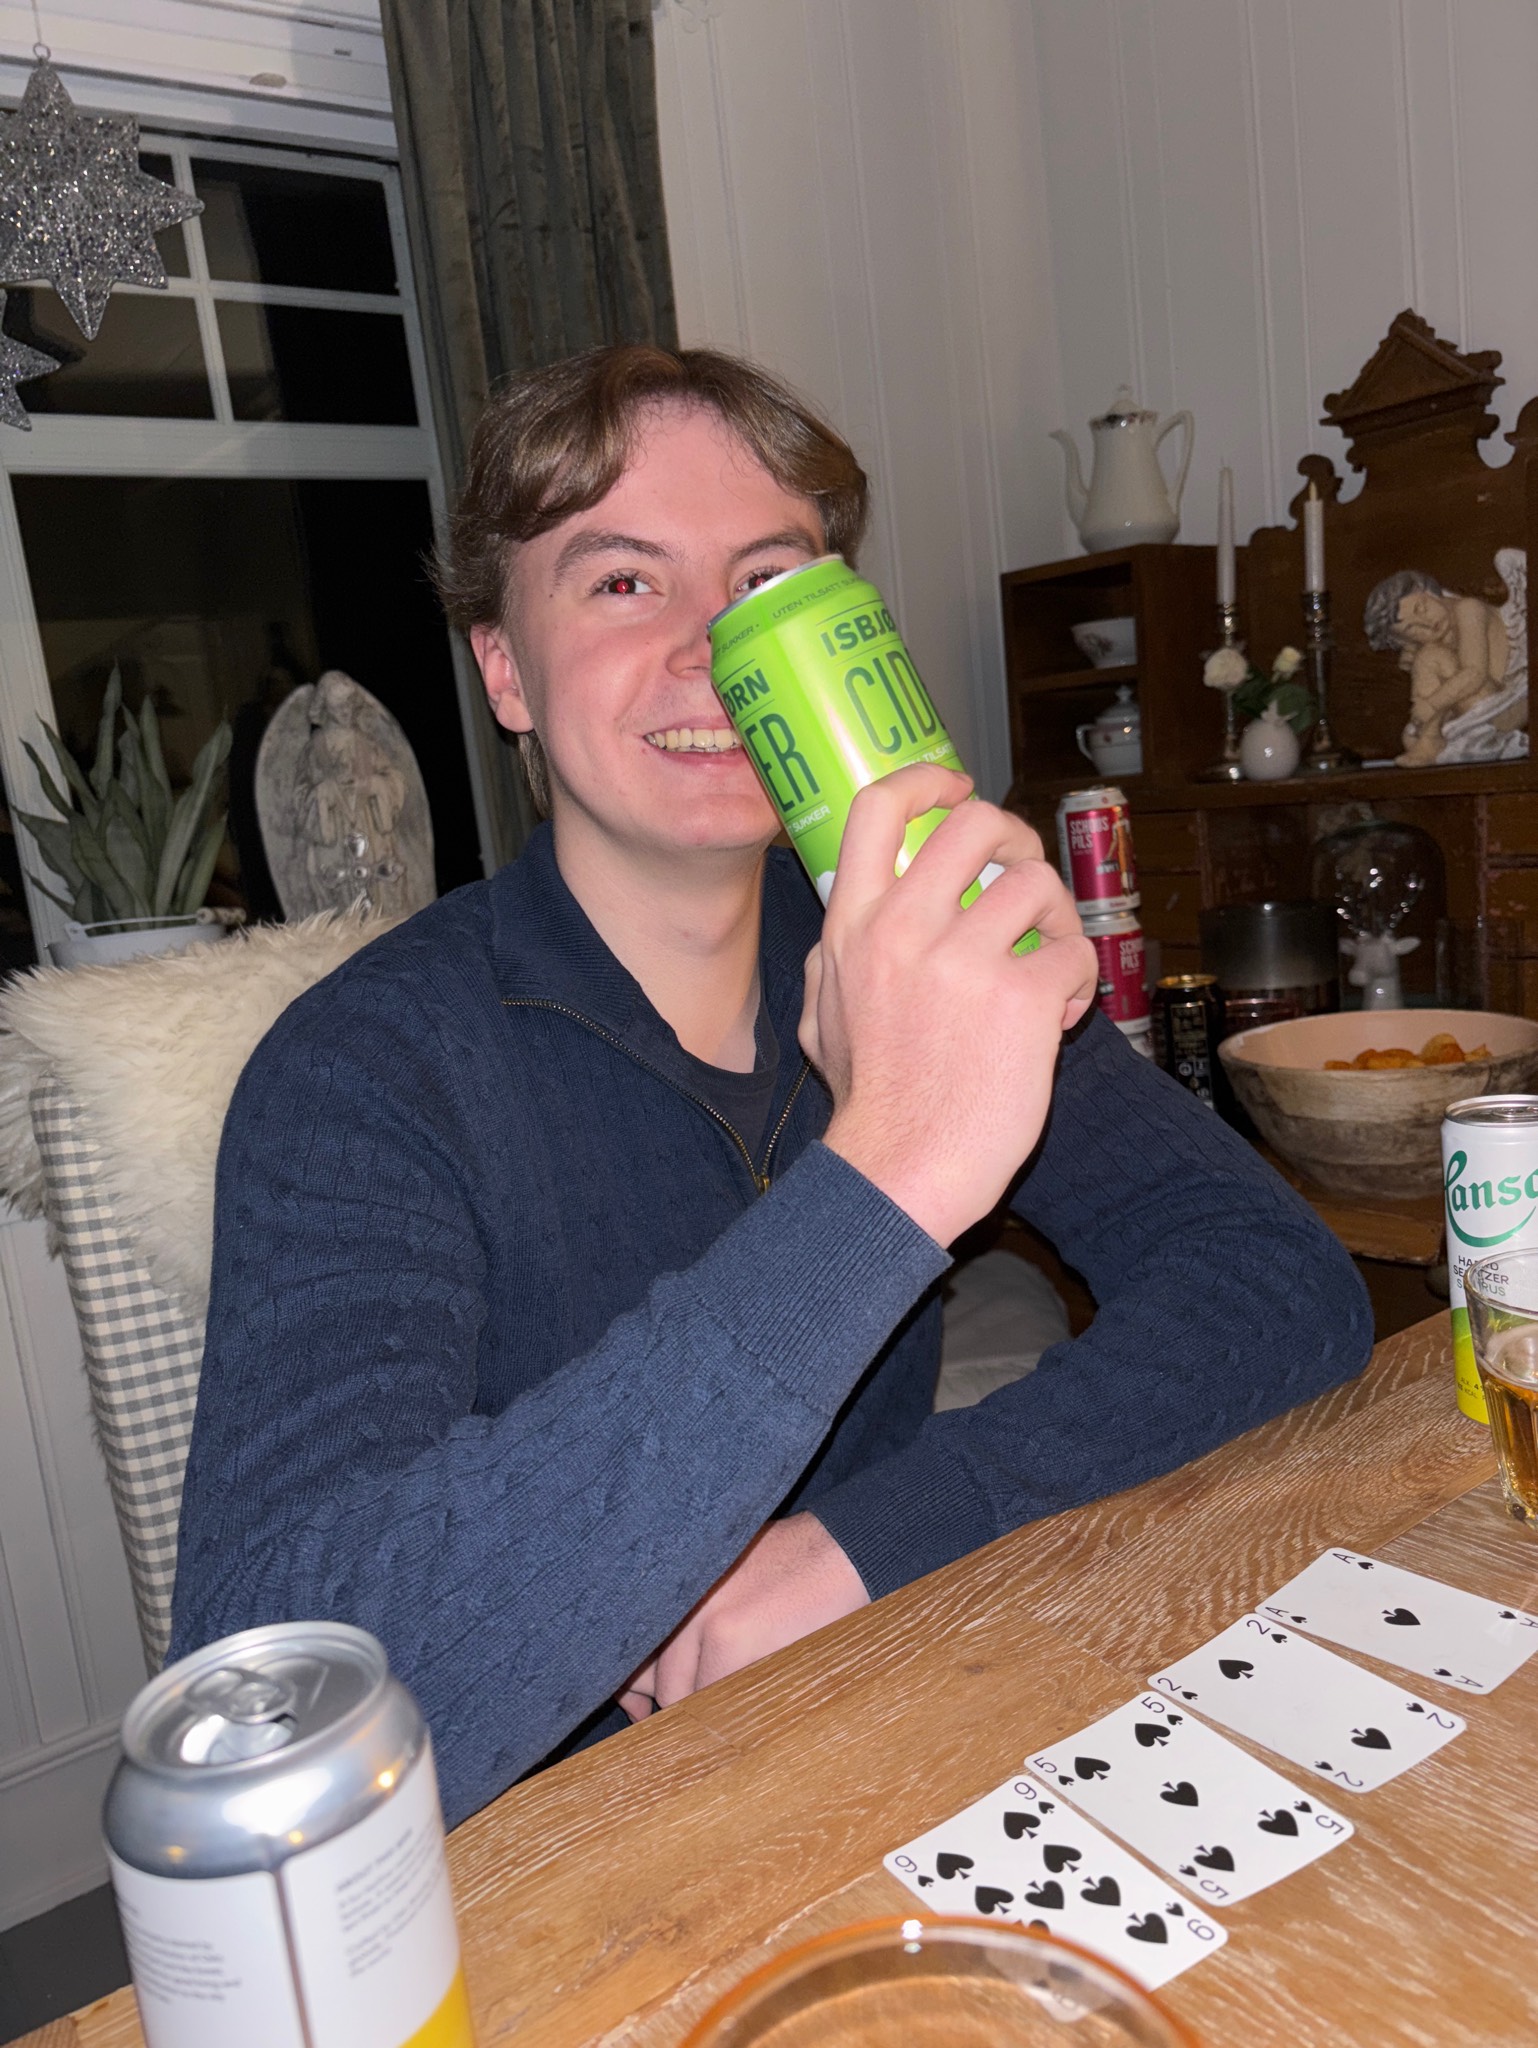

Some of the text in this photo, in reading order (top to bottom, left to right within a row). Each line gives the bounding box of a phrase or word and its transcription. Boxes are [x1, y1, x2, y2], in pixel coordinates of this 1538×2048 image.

[772, 582, 841, 619] UTEN TILSATT
[844, 648, 945, 755] CID
[744, 713, 821, 813] ER
[792, 805, 832, 833] SUKKER
[1071, 833, 1095, 850] PILS
[1332, 1552, 1356, 1565] A
[1264, 1606, 1290, 1618] A
[1246, 1619, 1271, 1636] 2
[1156, 1677, 1182, 1692] 2
[1455, 1675, 1484, 1689] A
[1141, 1696, 1166, 1714] 5
[1426, 1712, 1455, 1730] 2
[1033, 1756, 1058, 1775] 5
[1335, 1771, 1364, 1789] 2
[1013, 1781, 1038, 1801] 9
[1315, 1813, 1345, 1837] 5
[894, 1854, 919, 1875] 9
[1199, 1877, 1229, 1902] 5
